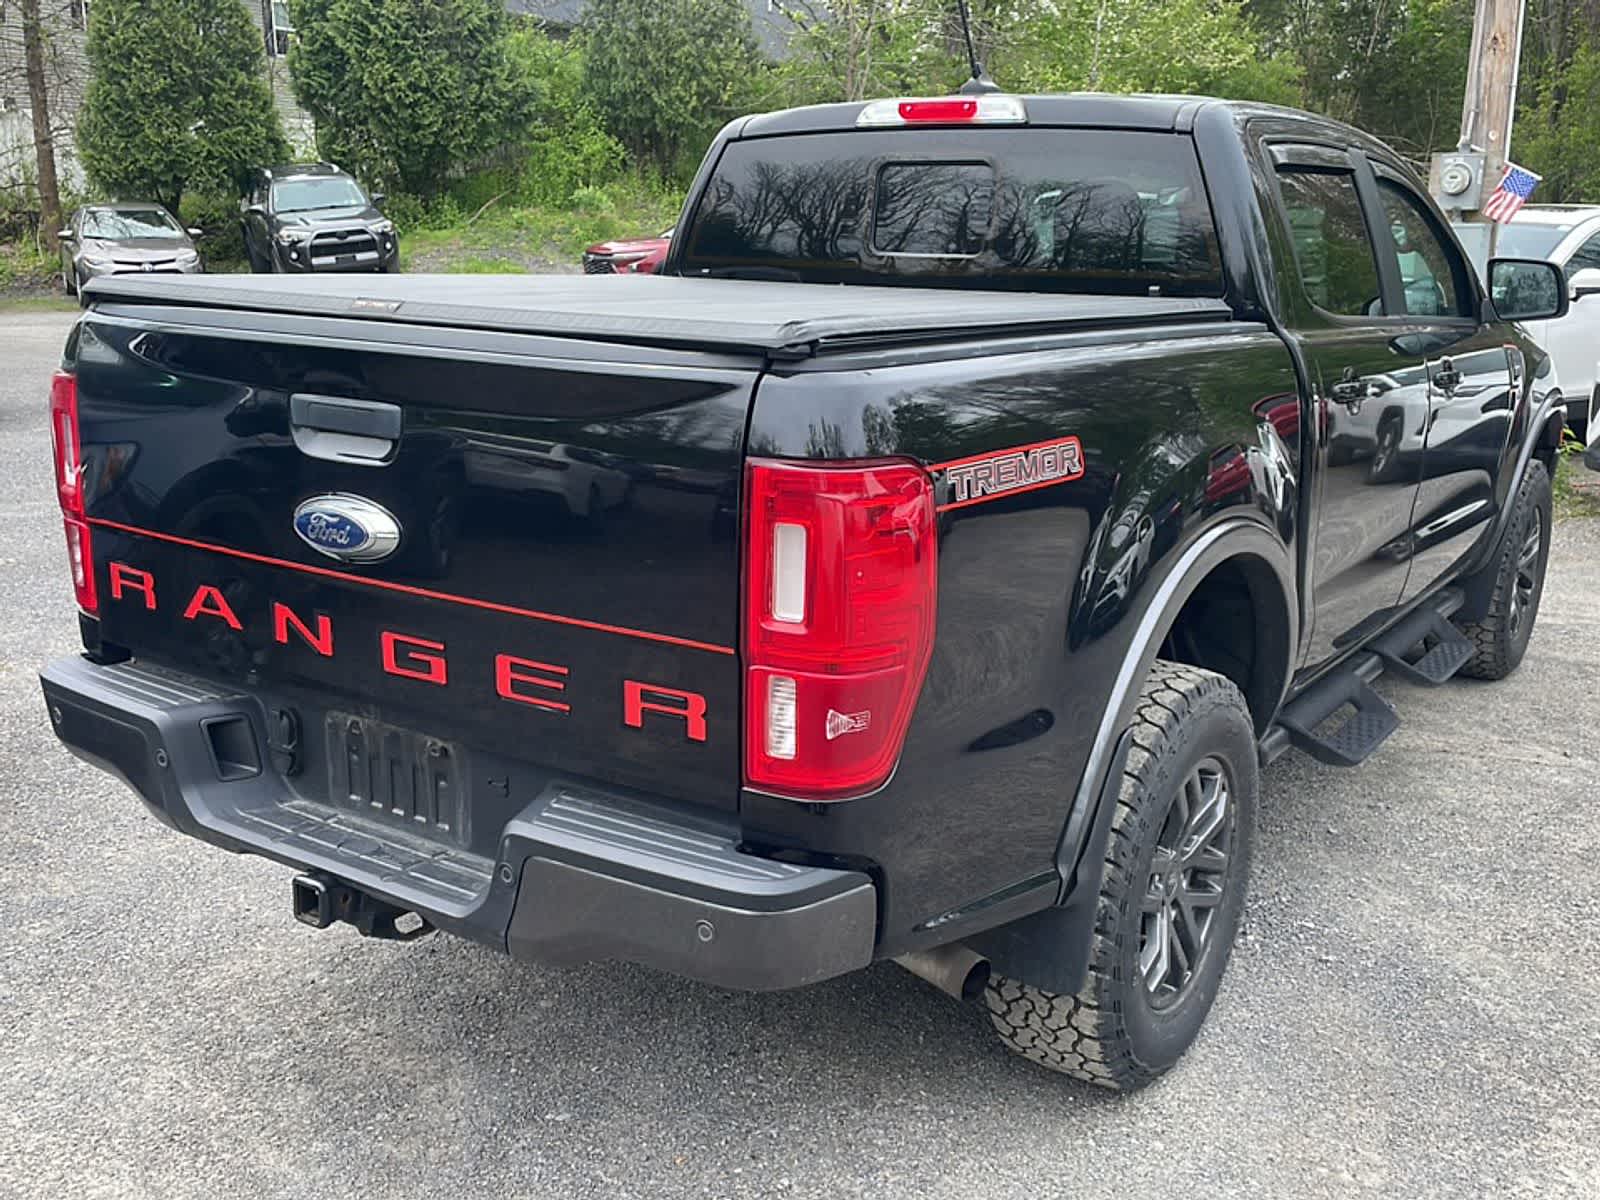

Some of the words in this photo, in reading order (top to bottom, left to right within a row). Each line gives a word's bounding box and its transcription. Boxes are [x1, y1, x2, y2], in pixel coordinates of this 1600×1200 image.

[946, 442, 1081, 502] TREMOR
[307, 512, 351, 545] Ford
[109, 562, 707, 741] RANGER
